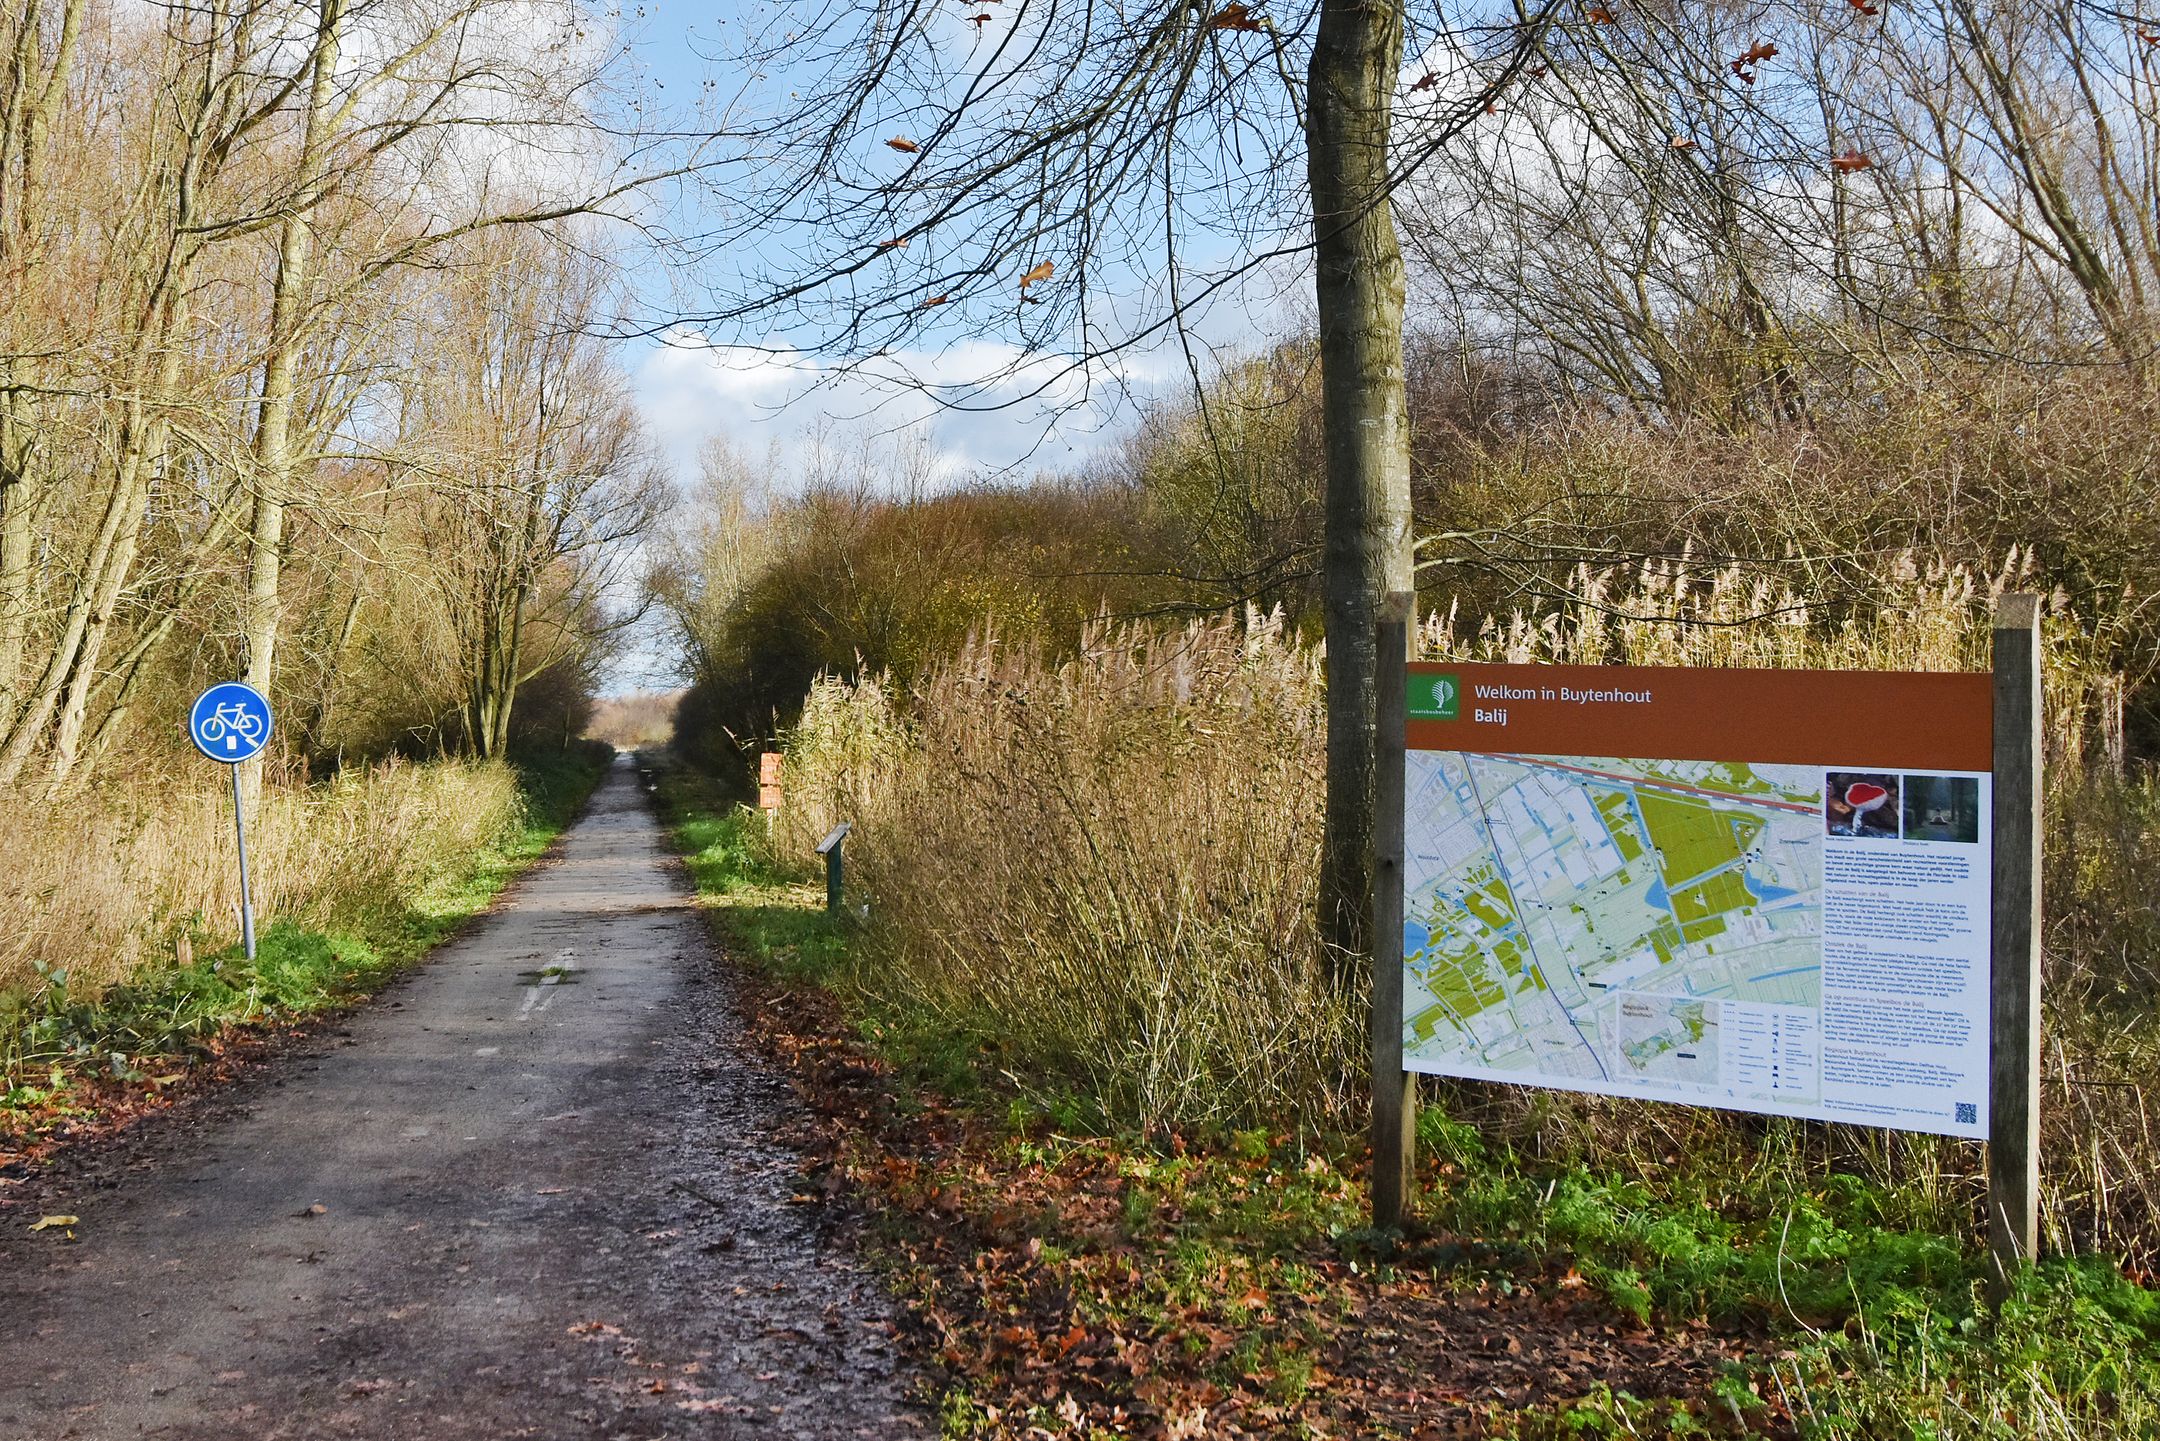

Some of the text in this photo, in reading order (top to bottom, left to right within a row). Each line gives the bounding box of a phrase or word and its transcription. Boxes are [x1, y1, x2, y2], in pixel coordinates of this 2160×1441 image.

[1474, 684, 1651, 705] Welkom in Buytenhout
[1474, 708, 1508, 727] Balij
